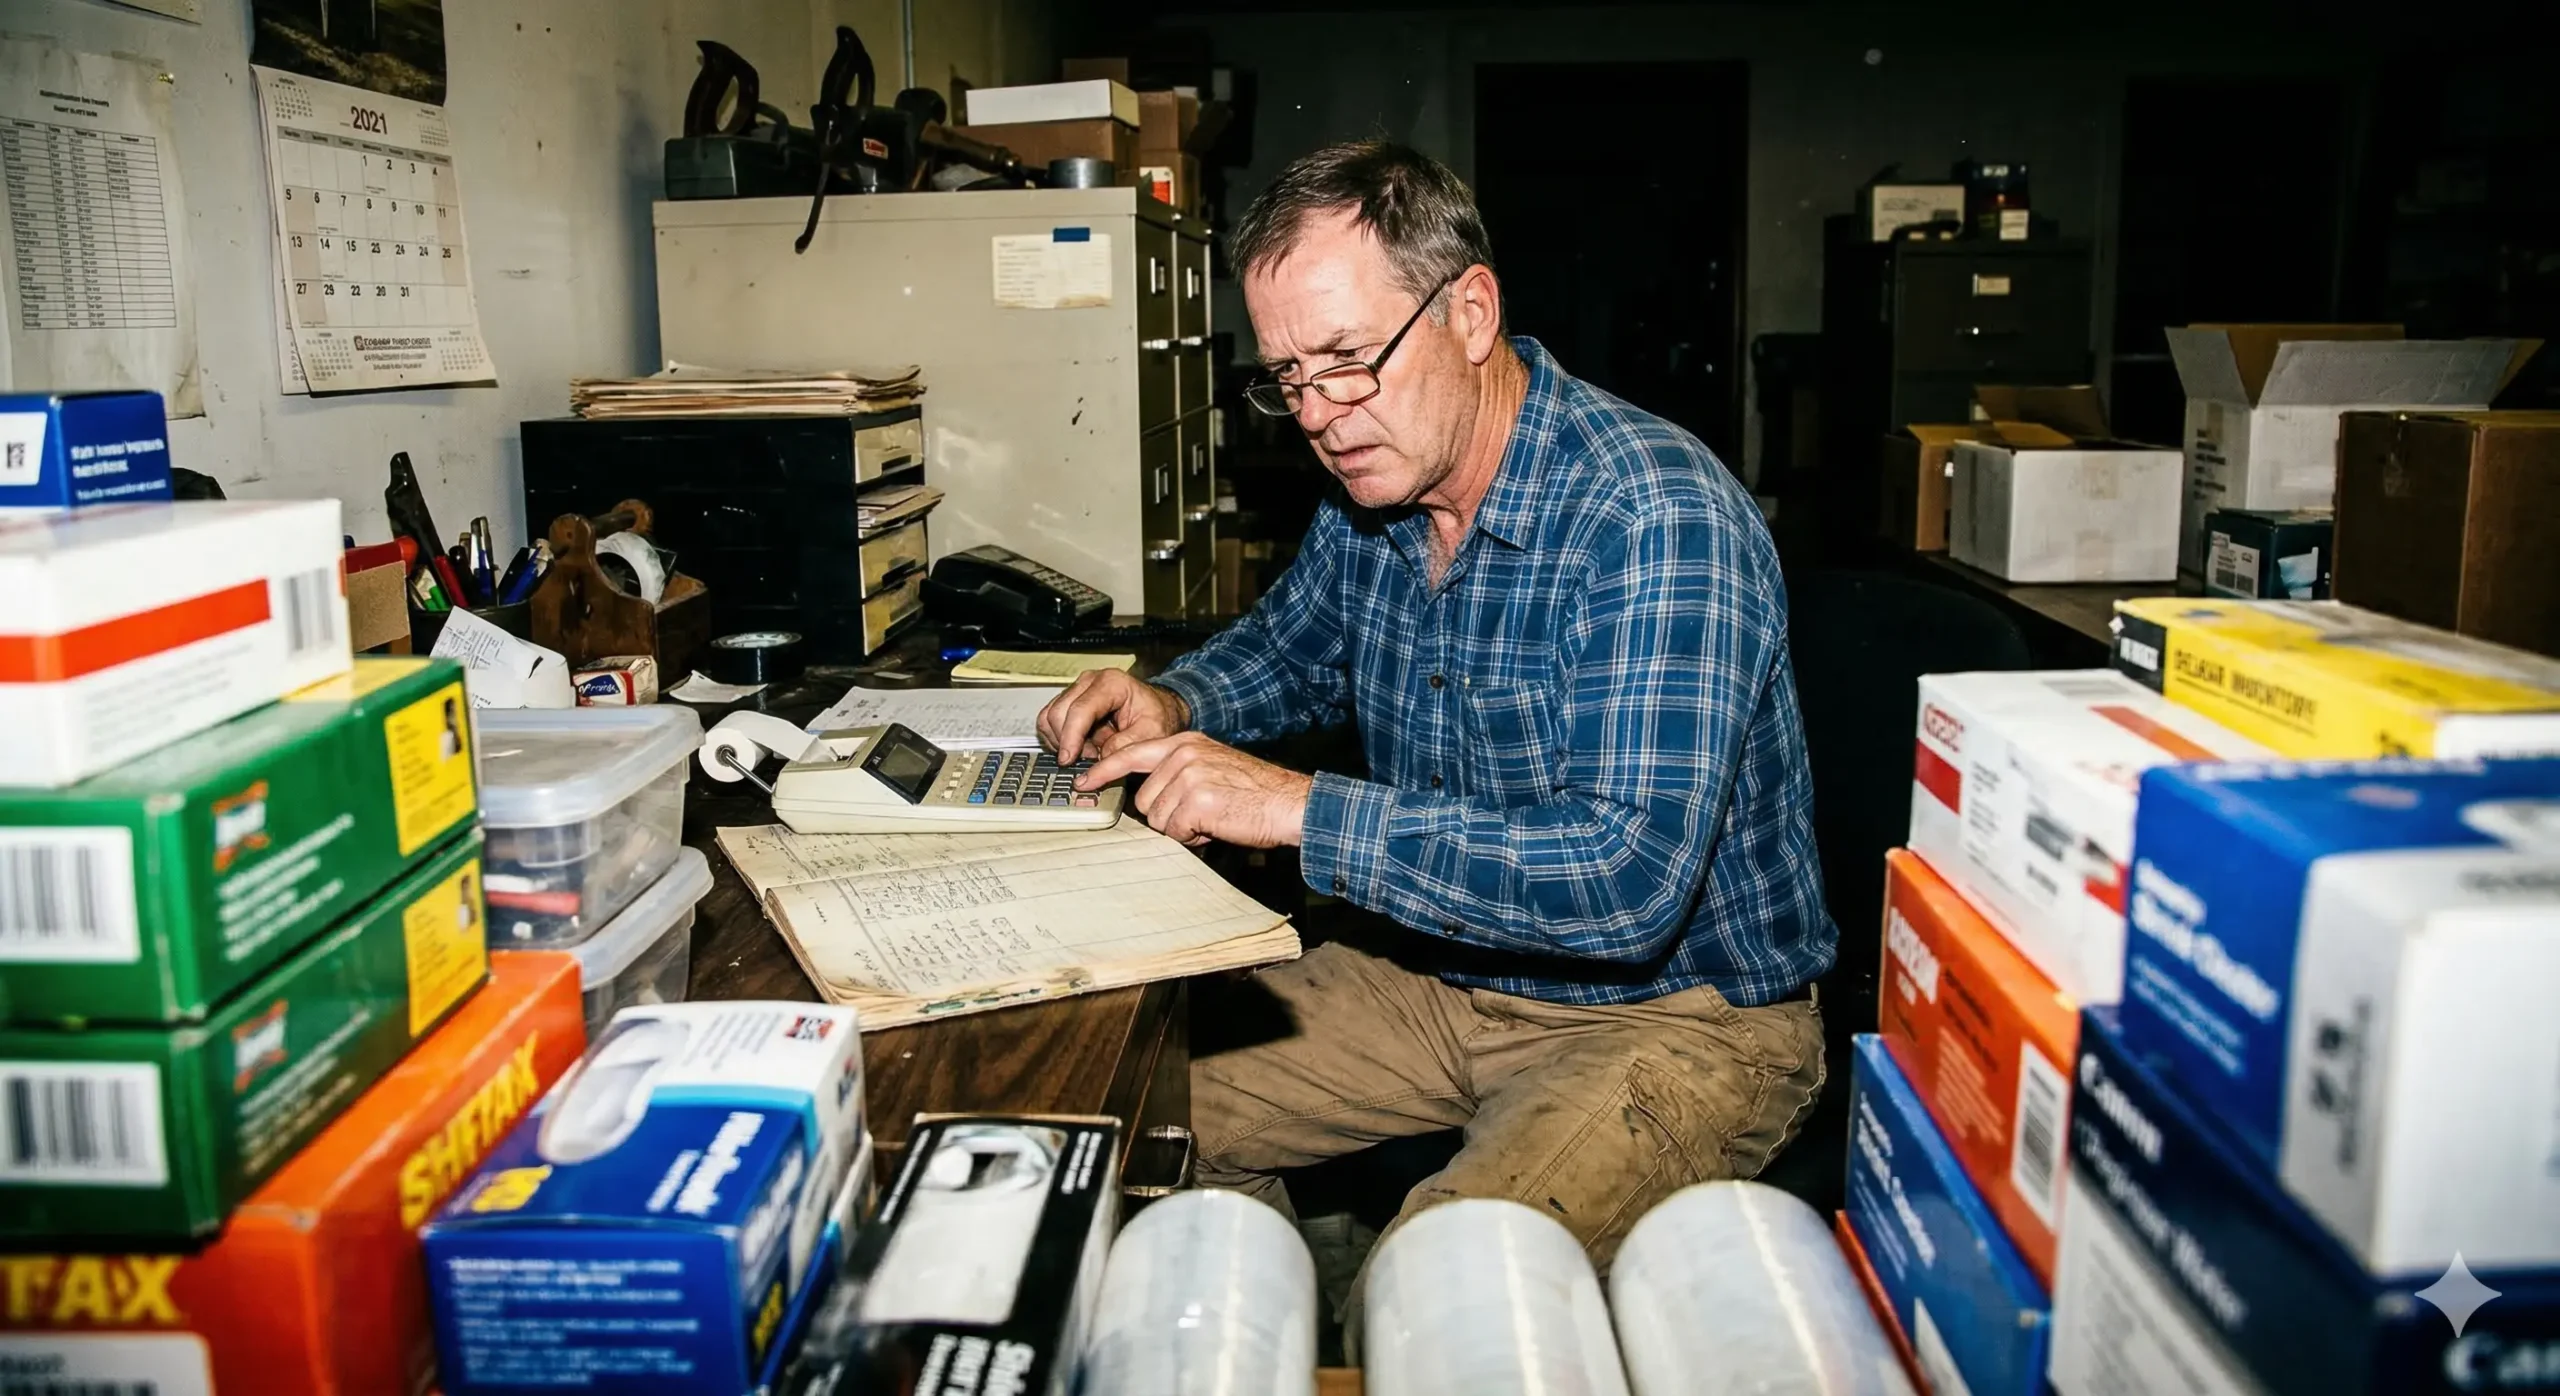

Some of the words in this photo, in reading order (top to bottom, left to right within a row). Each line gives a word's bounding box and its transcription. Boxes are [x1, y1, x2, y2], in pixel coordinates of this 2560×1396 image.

[350, 106, 388, 135] 2021
[362, 154, 368, 167] 1
[385, 158, 393, 171] 2
[409, 162, 416, 175] 3
[431, 166, 439, 177] 4
[285, 188, 292, 201] 5
[313, 191, 321, 204] 6
[339, 194, 347, 207] 7
[414, 204, 425, 216] 10
[437, 207, 447, 219] 11
[291, 235, 303, 249] 13
[319, 237, 331, 250] 14
[346, 240, 357, 252] 15
[295, 282, 307, 295] 27
[350, 284, 361, 297] 22
[400, 286, 410, 298] 31
